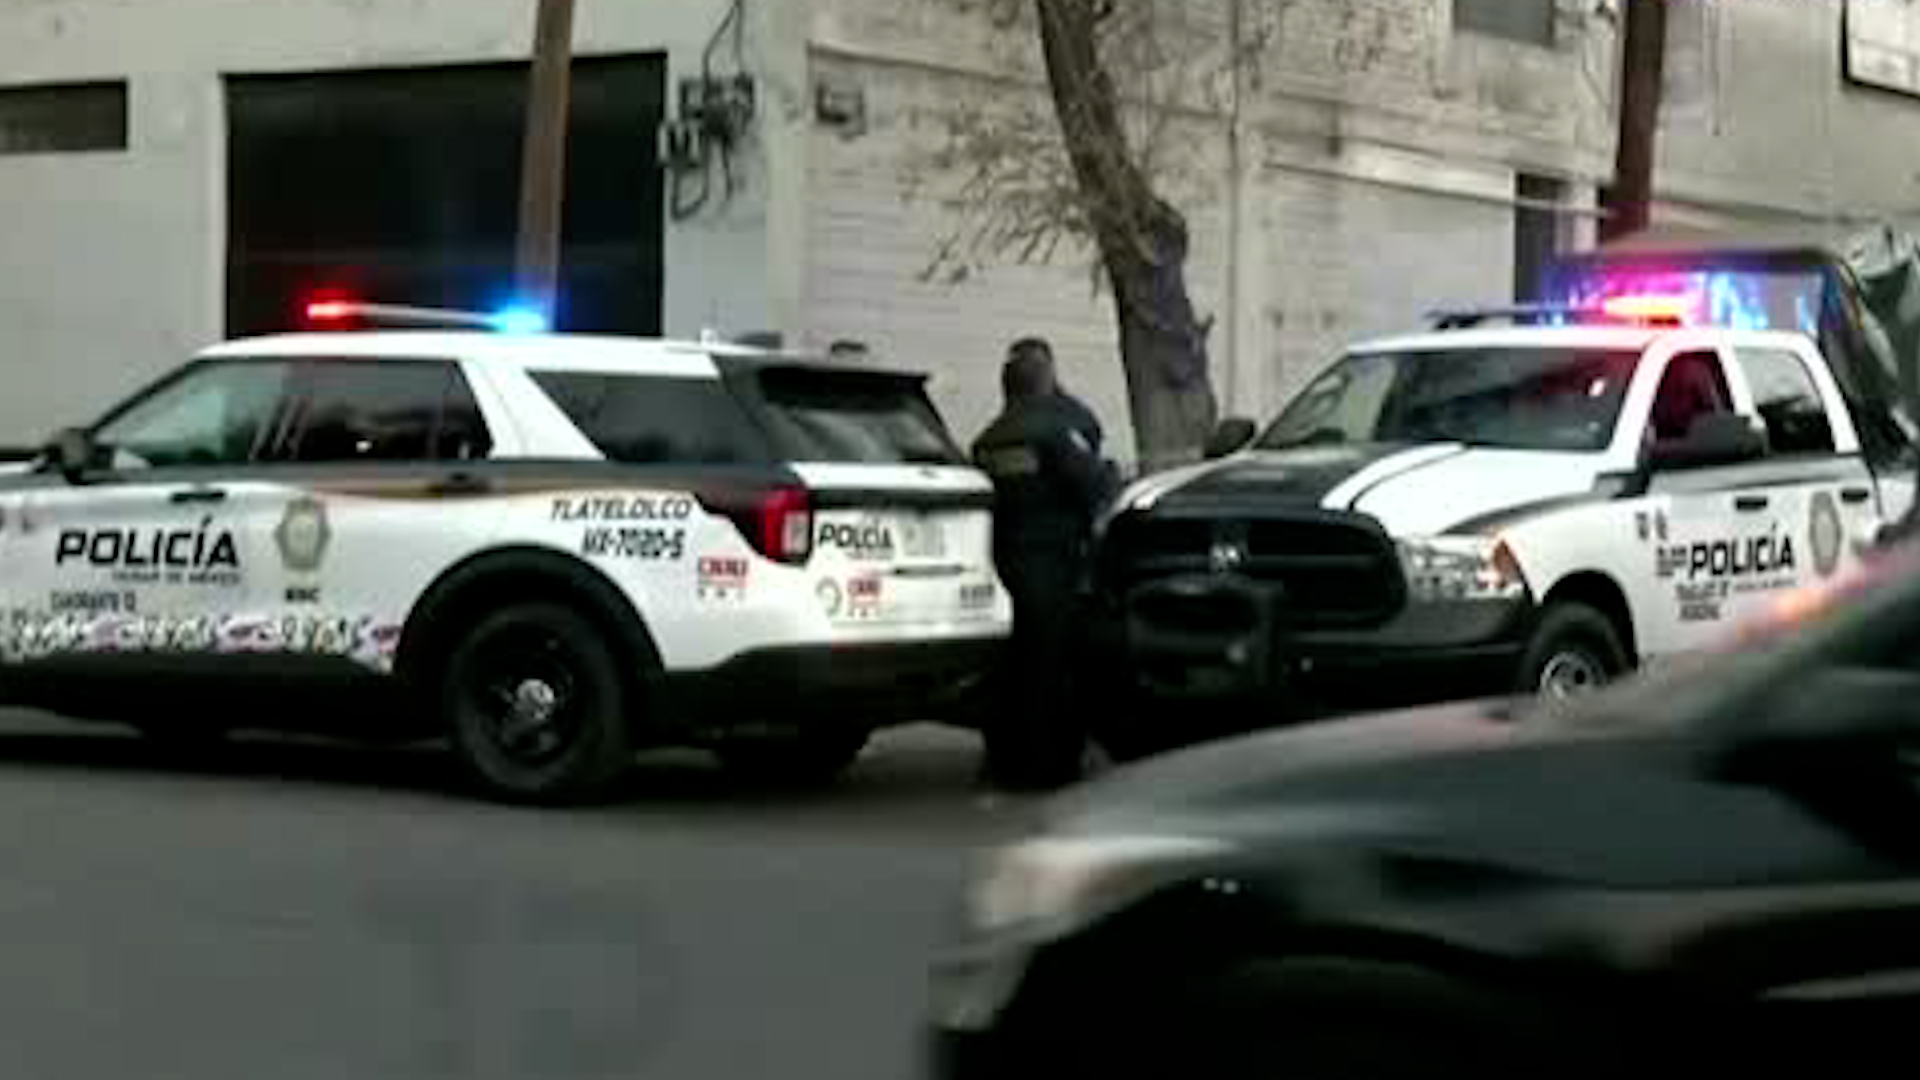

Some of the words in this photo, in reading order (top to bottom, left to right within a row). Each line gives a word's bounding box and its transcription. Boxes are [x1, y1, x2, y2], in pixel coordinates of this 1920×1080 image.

[549, 497, 692, 520] TLATELOLCO
[56, 514, 240, 569] POLICÍA
[1689, 522, 1795, 579] POLICÍA
